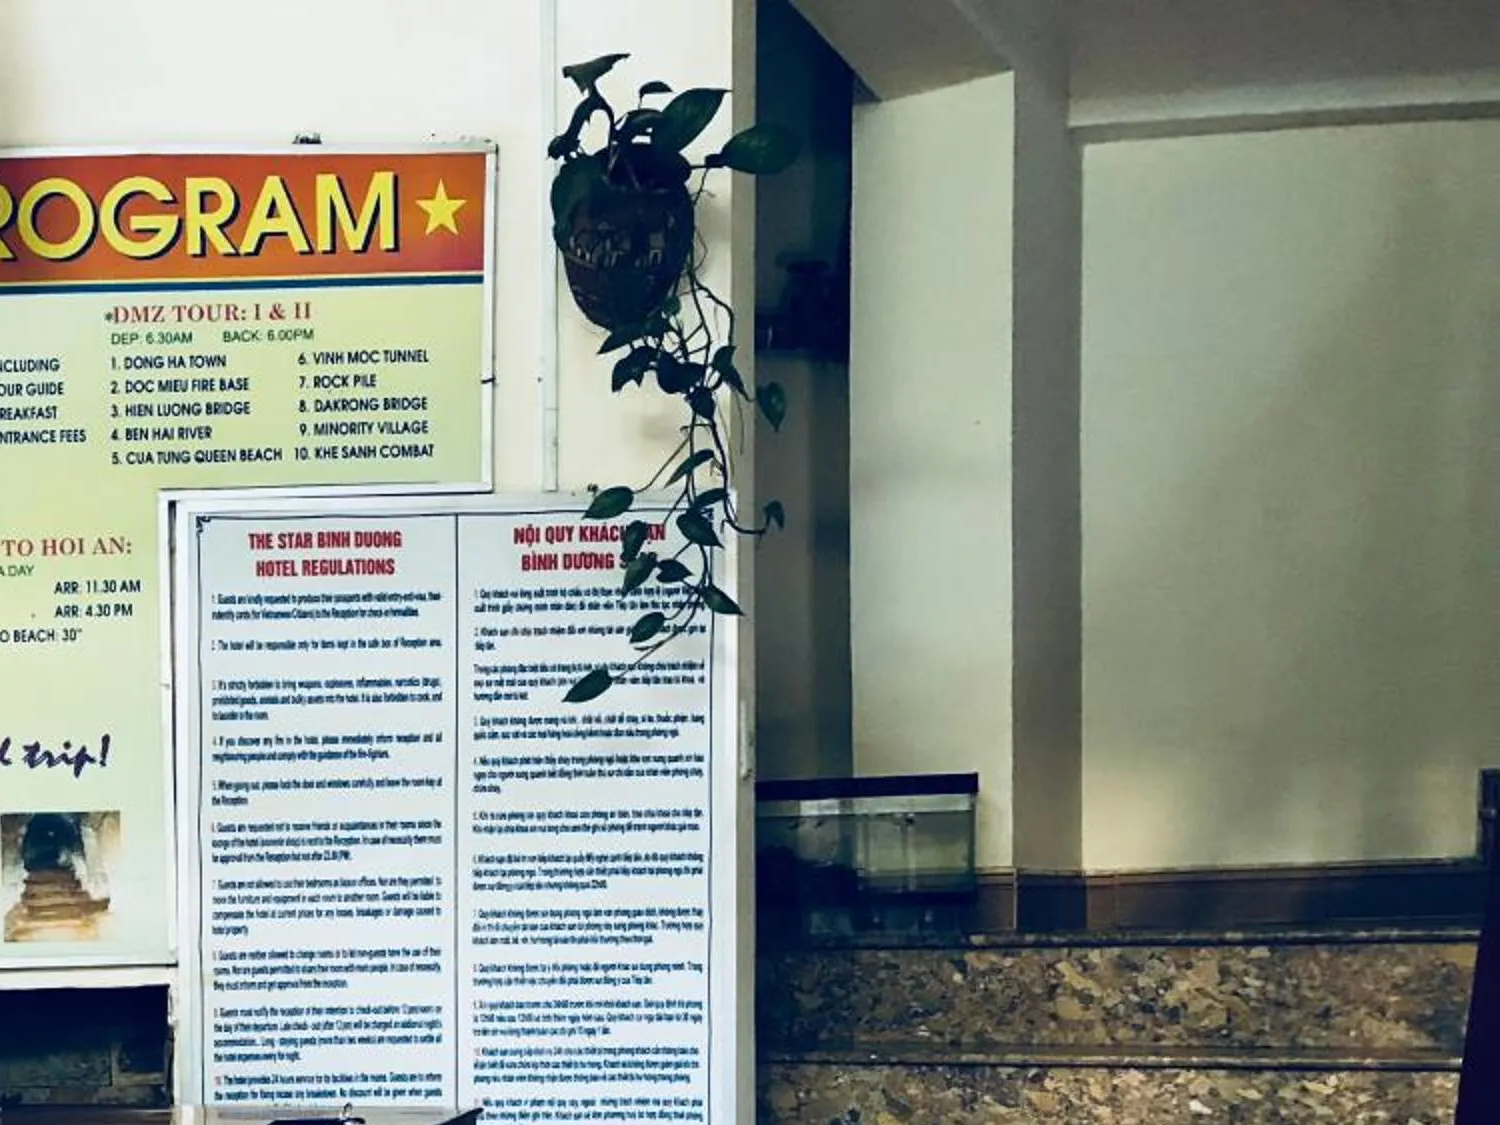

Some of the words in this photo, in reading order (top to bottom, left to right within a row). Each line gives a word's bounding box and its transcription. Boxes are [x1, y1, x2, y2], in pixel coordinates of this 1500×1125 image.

[113, 305, 166, 324] DMZ
[171, 303, 246, 323] TOUR:
[269, 303, 287, 320] &
[145, 331, 193, 344] 6.30AM
[223, 330, 263, 343] BACK:
[267, 328, 315, 341] 6.00PM
[124, 356, 165, 370] DONG
[167, 356, 186, 369] HA
[188, 355, 227, 368] TOWN
[313, 351, 344, 365] VINH
[347, 350, 380, 364] MOC
[383, 349, 429, 363] TUNNEL
[26, 382, 64, 396] GUIDE
[125, 380, 155, 394] DOC
[157, 379, 189, 393] MIEU
[191, 379, 216, 392] FIRE
[219, 377, 249, 391] BASE
[313, 375, 349, 389] ROCK
[353, 374, 377, 388] PILE
[125, 403, 154, 417] HIEN
[157, 402, 202, 417] LUONG
[205, 401, 250, 415] BRIDGE
[314, 398, 379, 413] DAKRONG
[382, 397, 428, 411] BRIDGE
[125, 427, 149, 441] BEN
[152, 426, 175, 441] HAI
[177, 426, 212, 439] RIVER
[313, 421, 375, 436] MINORITY
[377, 420, 429, 434] VILLAGE
[59, 430, 86, 443] FEES
[126, 451, 155, 465] CUA
[158, 450, 191, 464] TUNG
[193, 449, 237, 464] QUEEN
[239, 448, 282, 462] BEACH
[294, 447, 311, 461] 10.
[314, 446, 339, 460] KHE
[342, 445, 377, 459] SANH
[380, 443, 435, 458] COMBAT
[248, 533, 274, 549] THE
[278, 532, 313, 549] STAR
[317, 531, 351, 548] BINH
[354, 531, 403, 548] DUONG
[545, 525, 573, 544] QUY
[0, 539, 34, 558] TO
[41, 537, 86, 556] HOI
[91, 535, 133, 555] AN:
[256, 560, 299, 577] HOTEL
[302, 558, 395, 577] REGULATIONS
[521, 551, 559, 571] BÌNH
[8, 565, 34, 577] DAY
[86, 580, 117, 593] 11.30
[85, 604, 112, 617] 4.30
[23, 733, 110, 778] trip!
